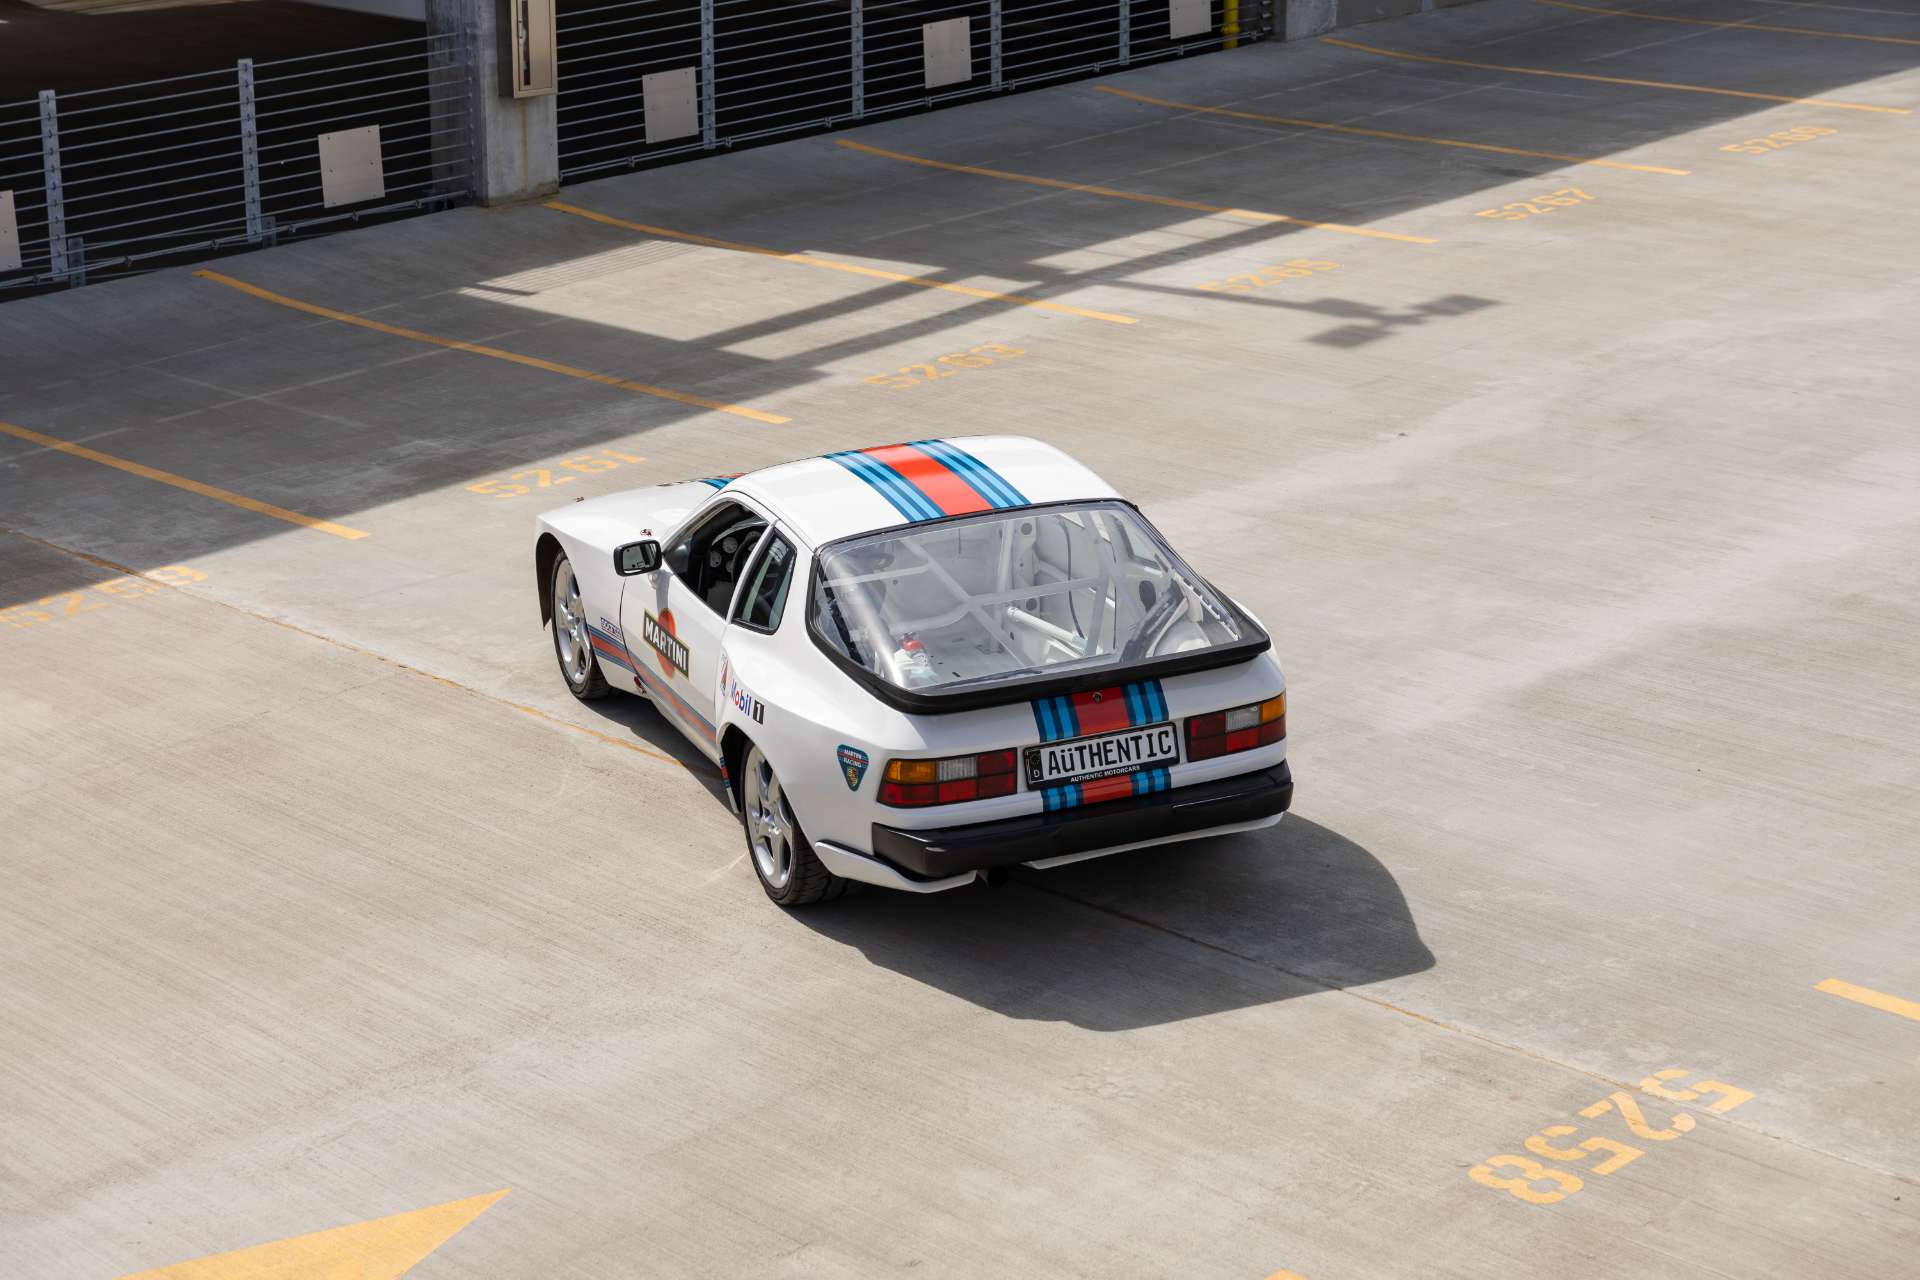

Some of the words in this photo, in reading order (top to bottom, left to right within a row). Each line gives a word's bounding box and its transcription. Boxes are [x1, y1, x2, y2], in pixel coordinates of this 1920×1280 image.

[1719, 126, 1838, 154] 5269
[1473, 187, 1597, 220] 5267
[1195, 258, 1343, 292] 5265
[864, 341, 1025, 390] 5263
[465, 448, 646, 498] 5261
[644, 620, 689, 671] MARTINI
[731, 679, 752, 717] Mobil
[1070, 771, 1104, 783] AUTHENTIC
[1104, 764, 1140, 777] MOTORCARS
[1467, 1068, 1758, 1206] 5258
